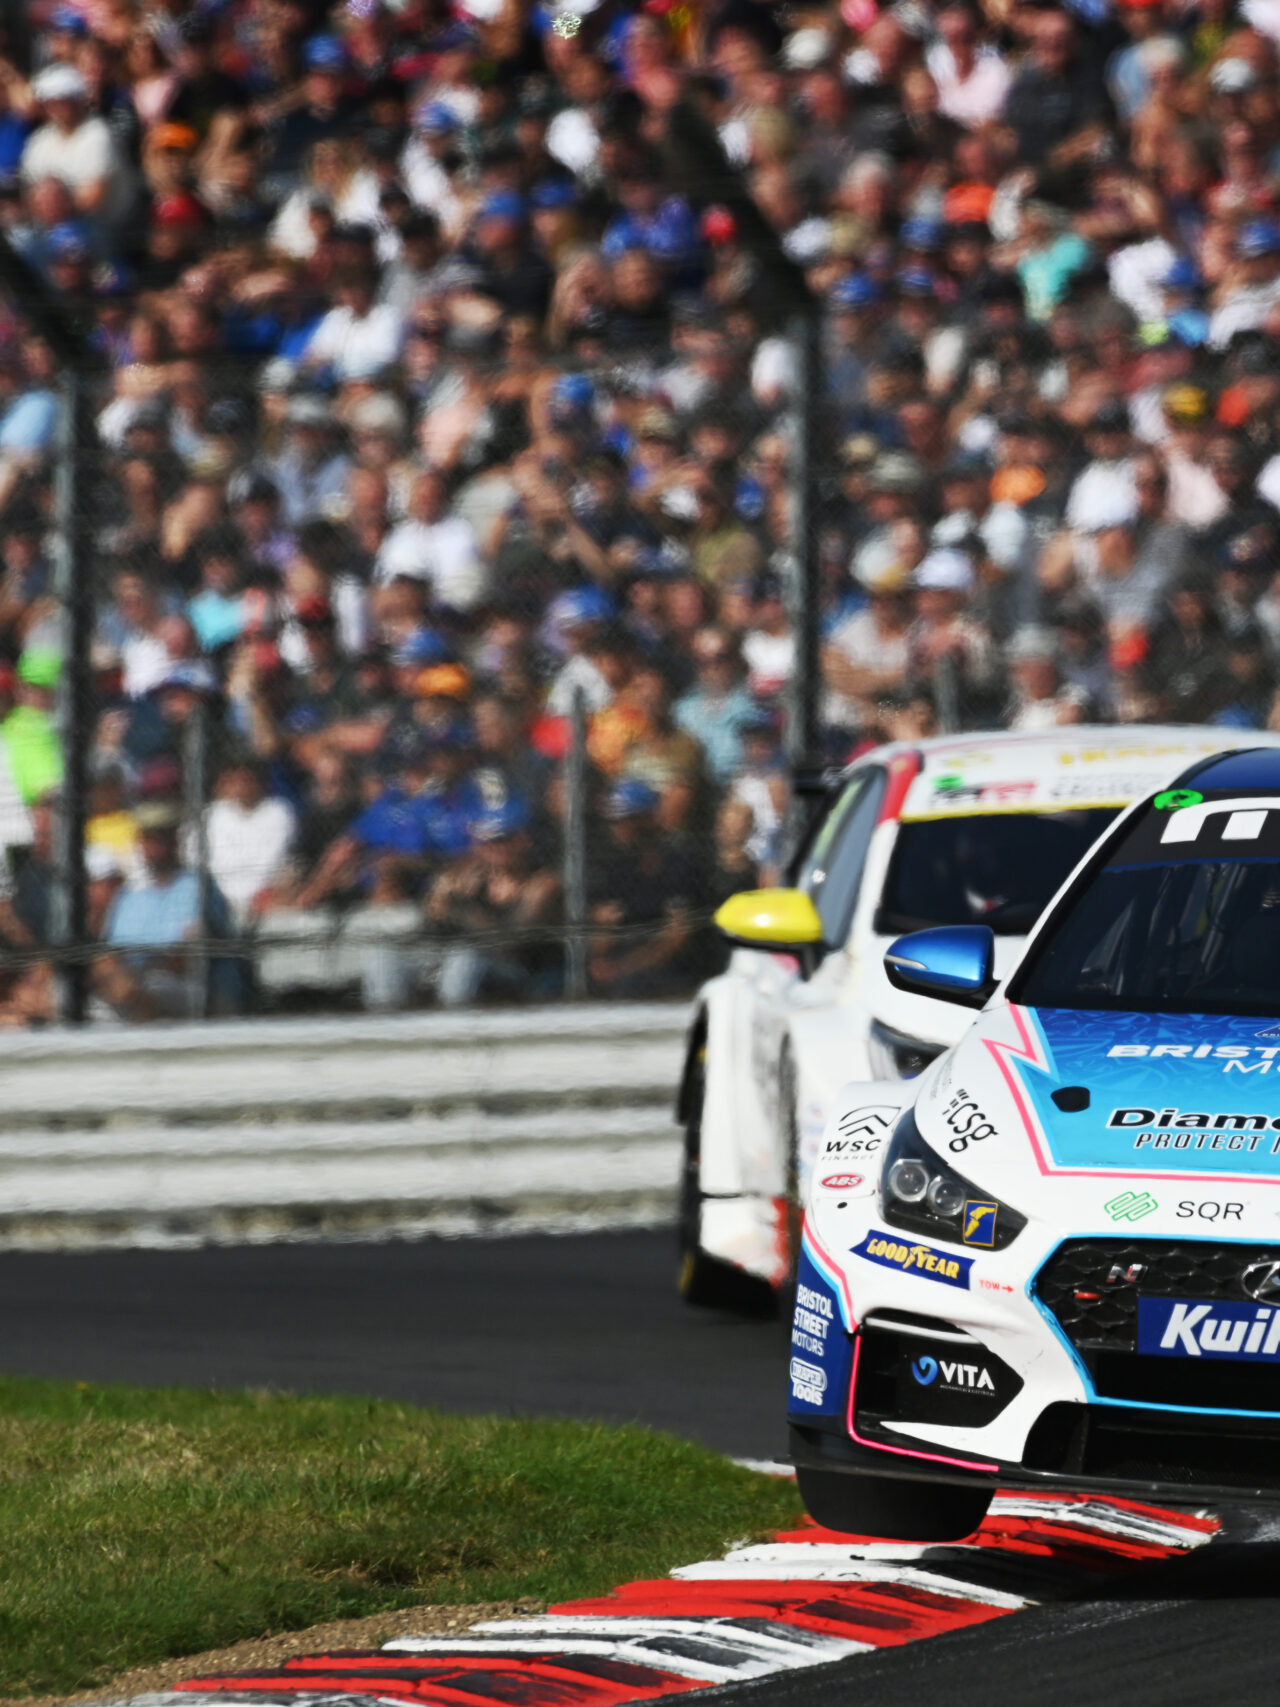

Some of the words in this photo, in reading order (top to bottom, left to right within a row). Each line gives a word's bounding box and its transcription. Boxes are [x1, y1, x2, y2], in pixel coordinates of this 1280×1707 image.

[946, 1103, 999, 1153] csg
[1133, 1132, 1264, 1153] PROTECT
[825, 1138, 882, 1153] WSC
[826, 1175, 862, 1188] ABS
[1175, 1200, 1245, 1222] SQR
[866, 1238, 960, 1280] GOODYEAR
[979, 1279, 1001, 1290] TOW
[797, 1284, 834, 1319] BRISTOL
[794, 1306, 829, 1339] STREET
[791, 1328, 825, 1357] MOTORS
[939, 1360, 996, 1391] VITA
